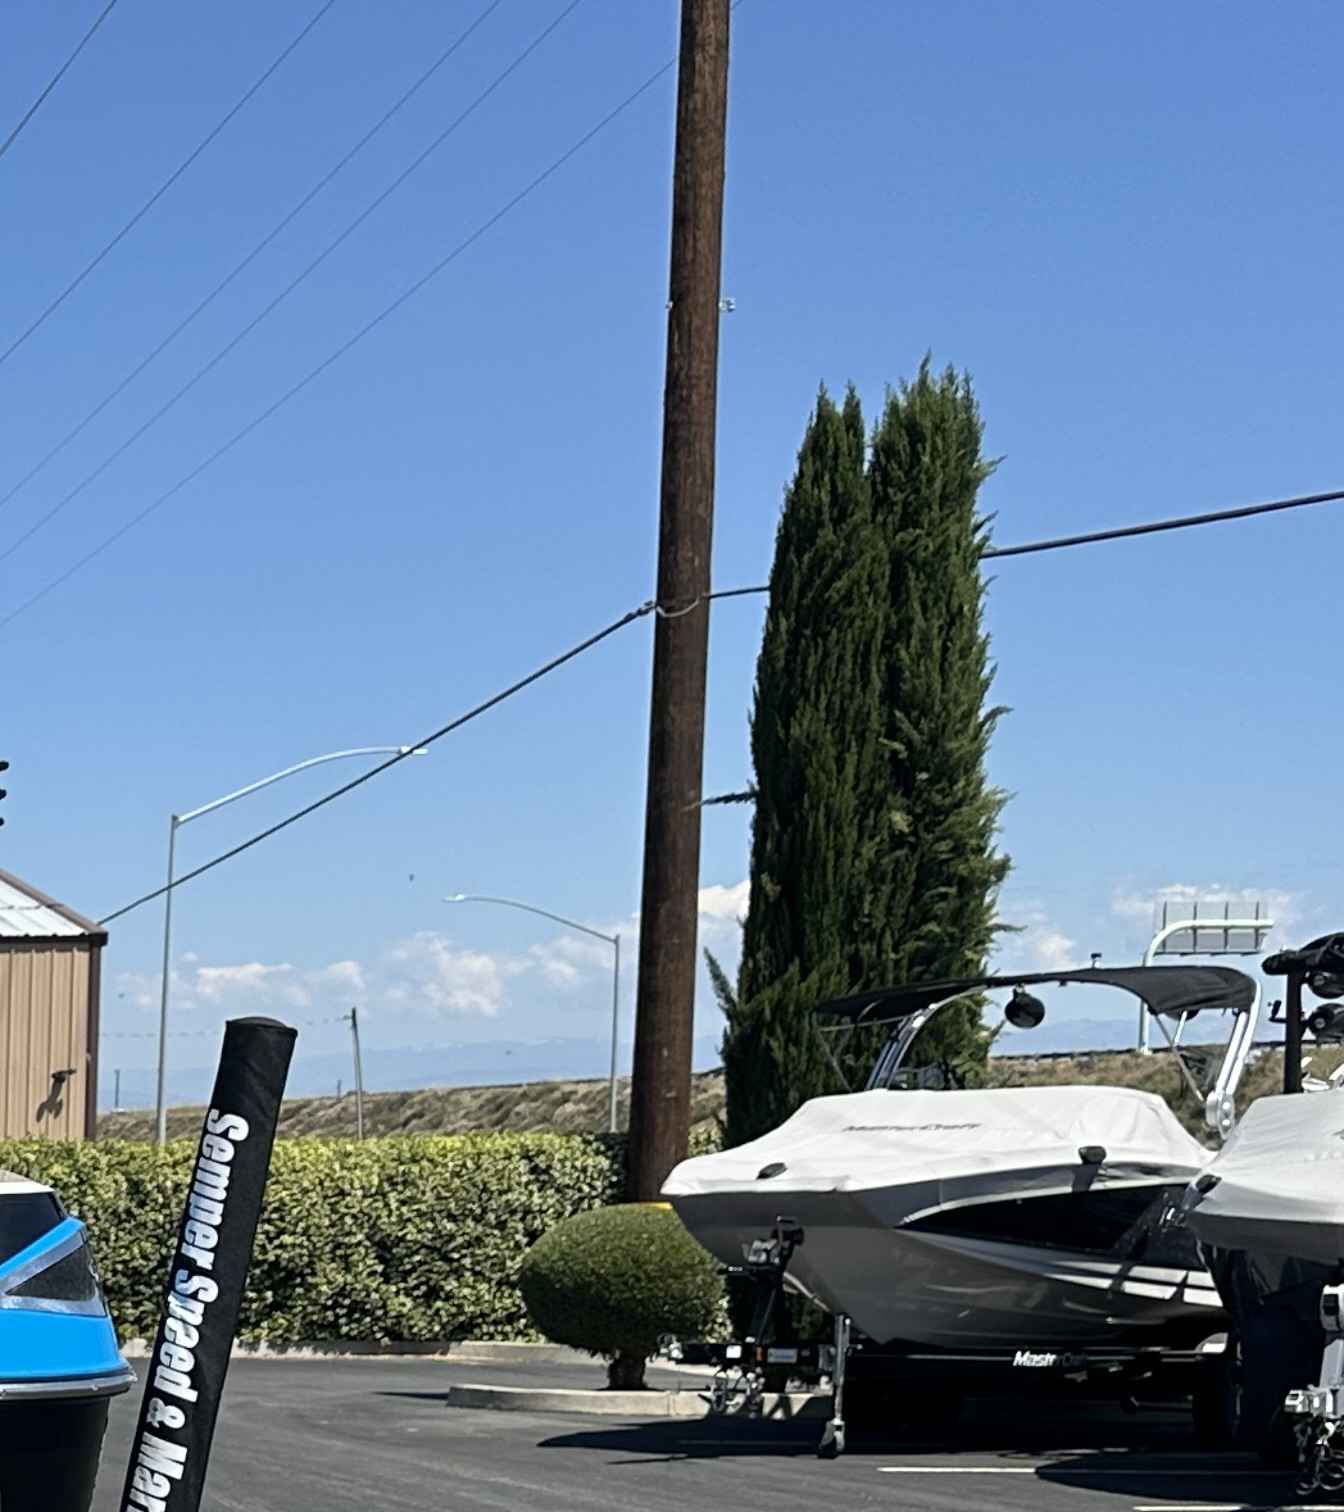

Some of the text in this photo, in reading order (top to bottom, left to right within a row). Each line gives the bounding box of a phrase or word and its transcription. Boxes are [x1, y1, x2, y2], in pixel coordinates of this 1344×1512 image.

[180, 1108, 250, 1271] Semper
[153, 1268, 219, 1403] Speed
[146, 1396, 186, 1430] &
